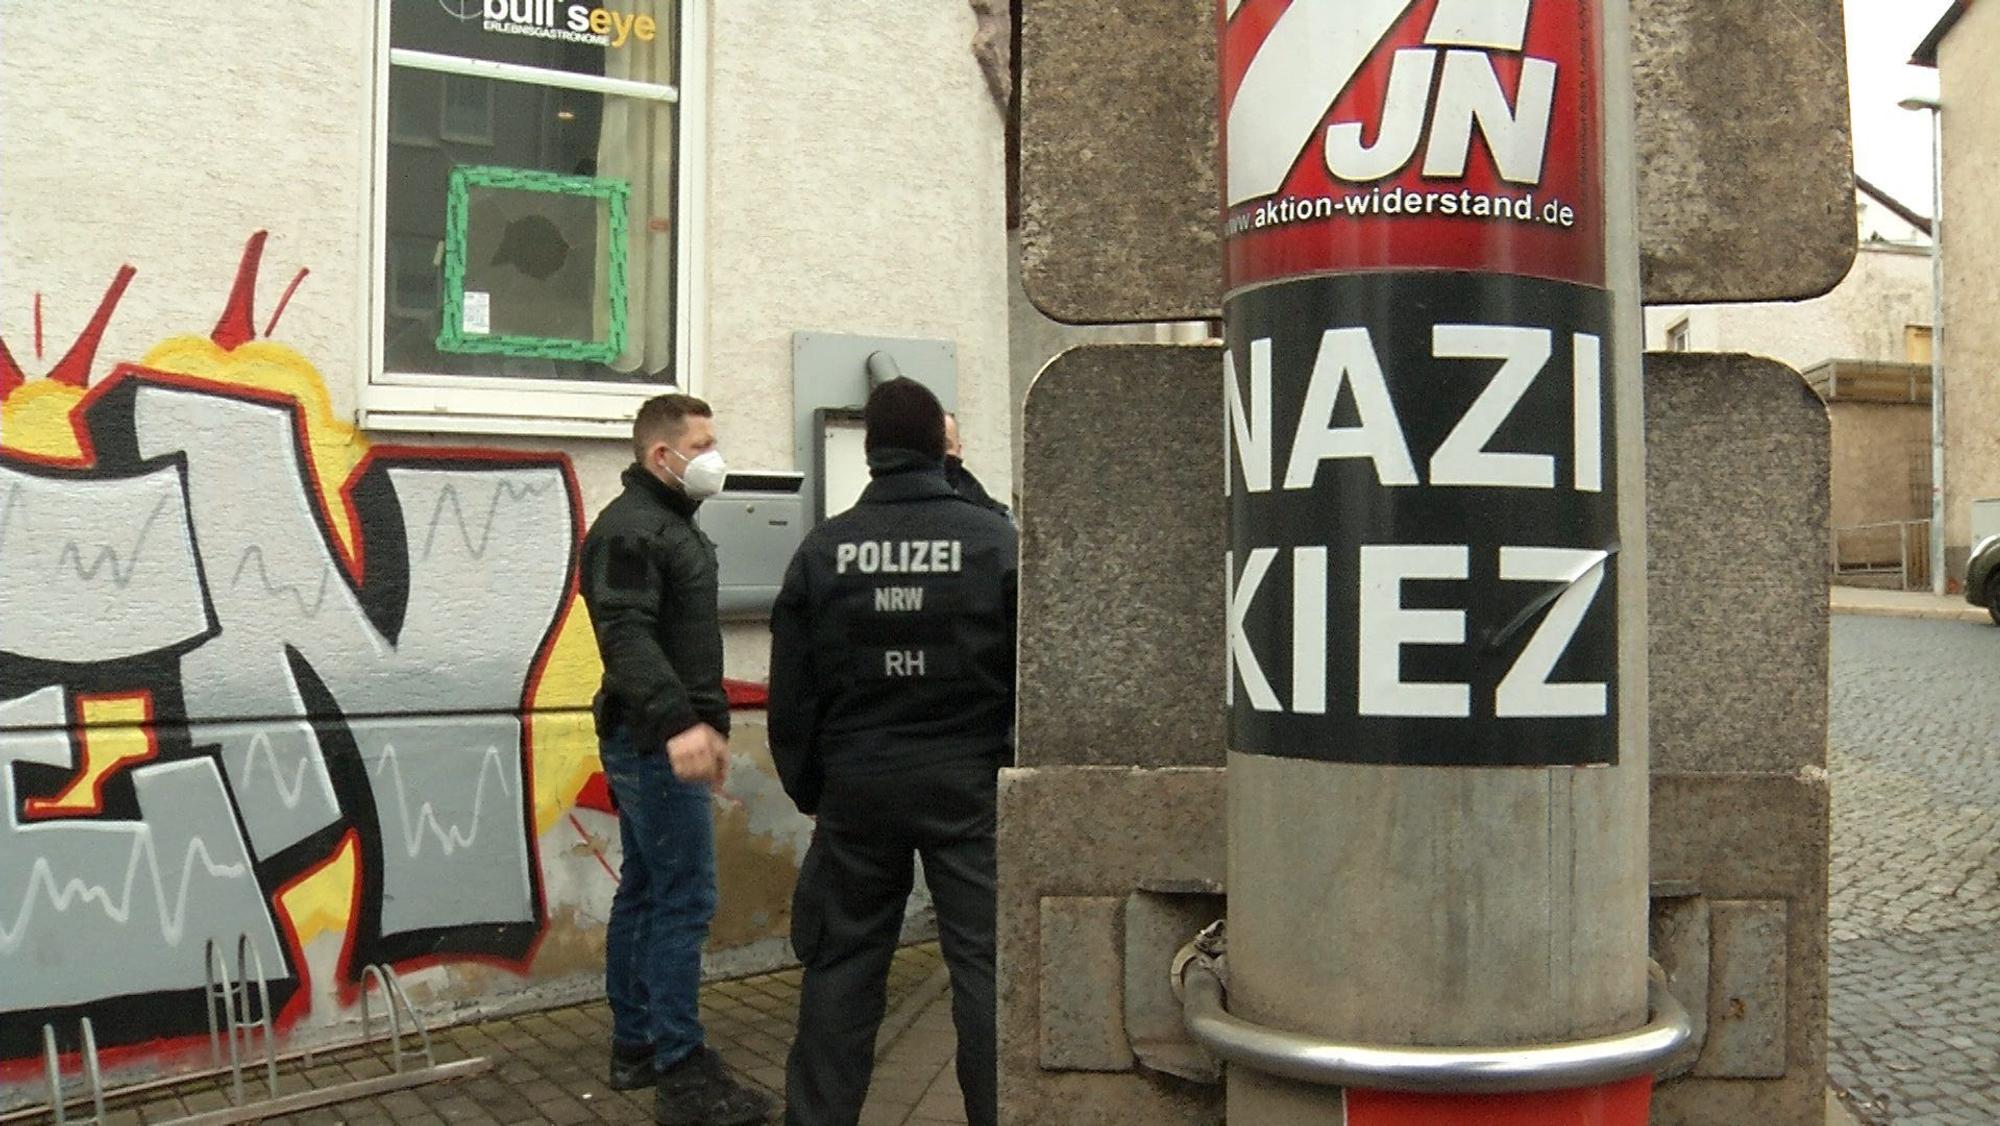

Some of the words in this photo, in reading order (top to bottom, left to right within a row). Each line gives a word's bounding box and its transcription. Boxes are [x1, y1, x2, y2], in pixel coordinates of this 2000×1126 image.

[1324, 48, 1557, 184] JN
[1224, 323, 1603, 497] NAZI
[836, 540, 962, 574] POLIZEI
[874, 587, 923, 611] NRW
[885, 650, 925, 676] RH
[1225, 544, 1610, 718] KIEZ
